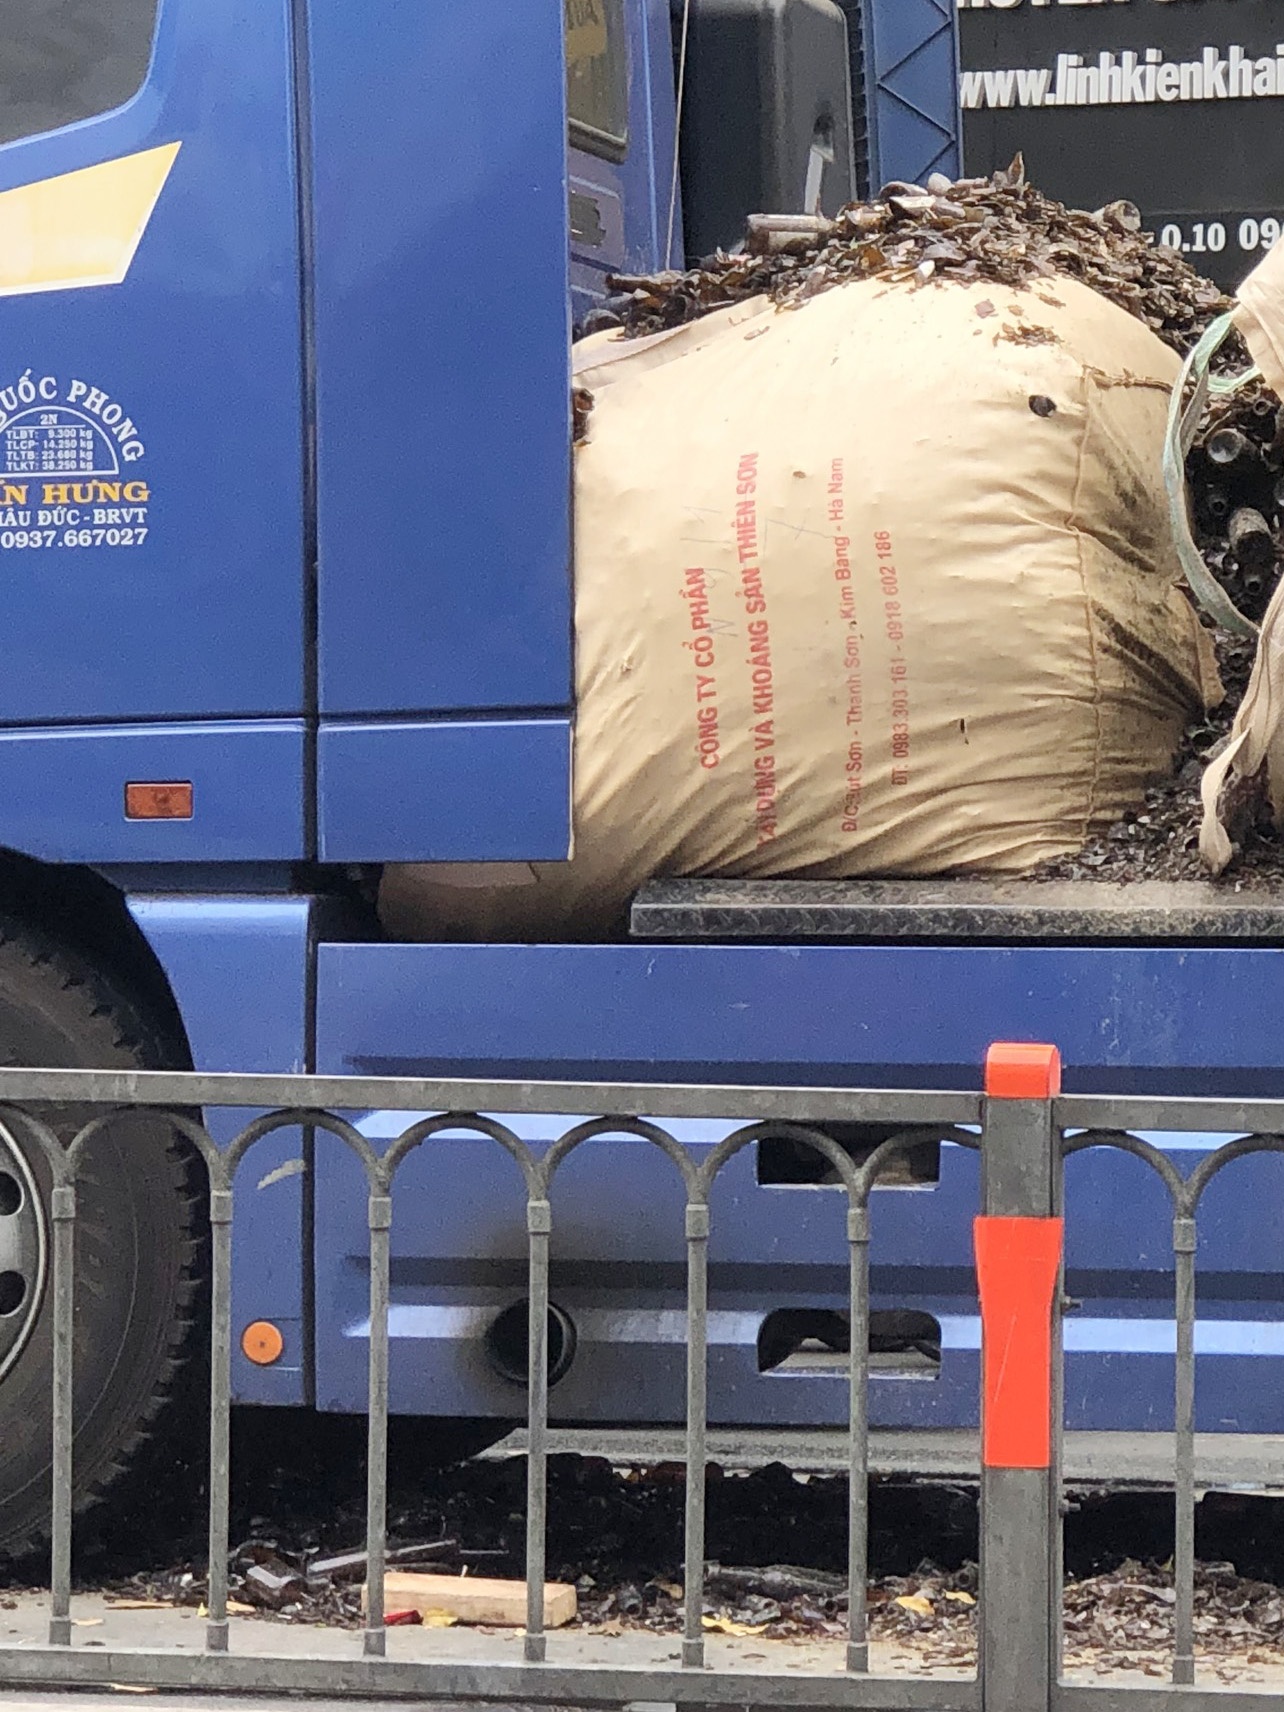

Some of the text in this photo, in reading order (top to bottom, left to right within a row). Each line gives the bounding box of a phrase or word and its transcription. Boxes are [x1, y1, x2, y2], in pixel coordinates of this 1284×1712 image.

[40, 413, 58, 426] 2N
[67, 379, 145, 462] PHONG
[79, 428, 93, 440] kg
[79, 438, 94, 450] kg
[79, 450, 93, 461] kg
[79, 460, 94, 472] kg
[827, 457, 844, 494] Nam
[42, 479, 150, 505] HƯNG
[37, 505, 80, 526] ĐỨC
[93, 507, 148, 525] BRVT
[828, 498, 844, 521] Hà
[1, 528, 149, 548] 0937.667027
[731, 500, 759, 564] THIÊN
[874, 530, 892, 560] 186
[735, 566, 767, 614] SẢN
[879, 566, 898, 596] 602
[679, 567, 711, 630] PHẦN
[839, 586, 856, 620] Kim
[885, 600, 903, 641] 0918
[682, 635, 715, 668] CỔ
[745, 620, 774, 714] KHOÁNG
[844, 635, 861, 669] Sơn
[696, 675, 717, 703] TY
[846, 673, 863, 726] Thanh
[695, 706, 720, 769] CÔNG
[748, 719, 775, 750] VÀ
[846, 741, 862, 772] Sơn
